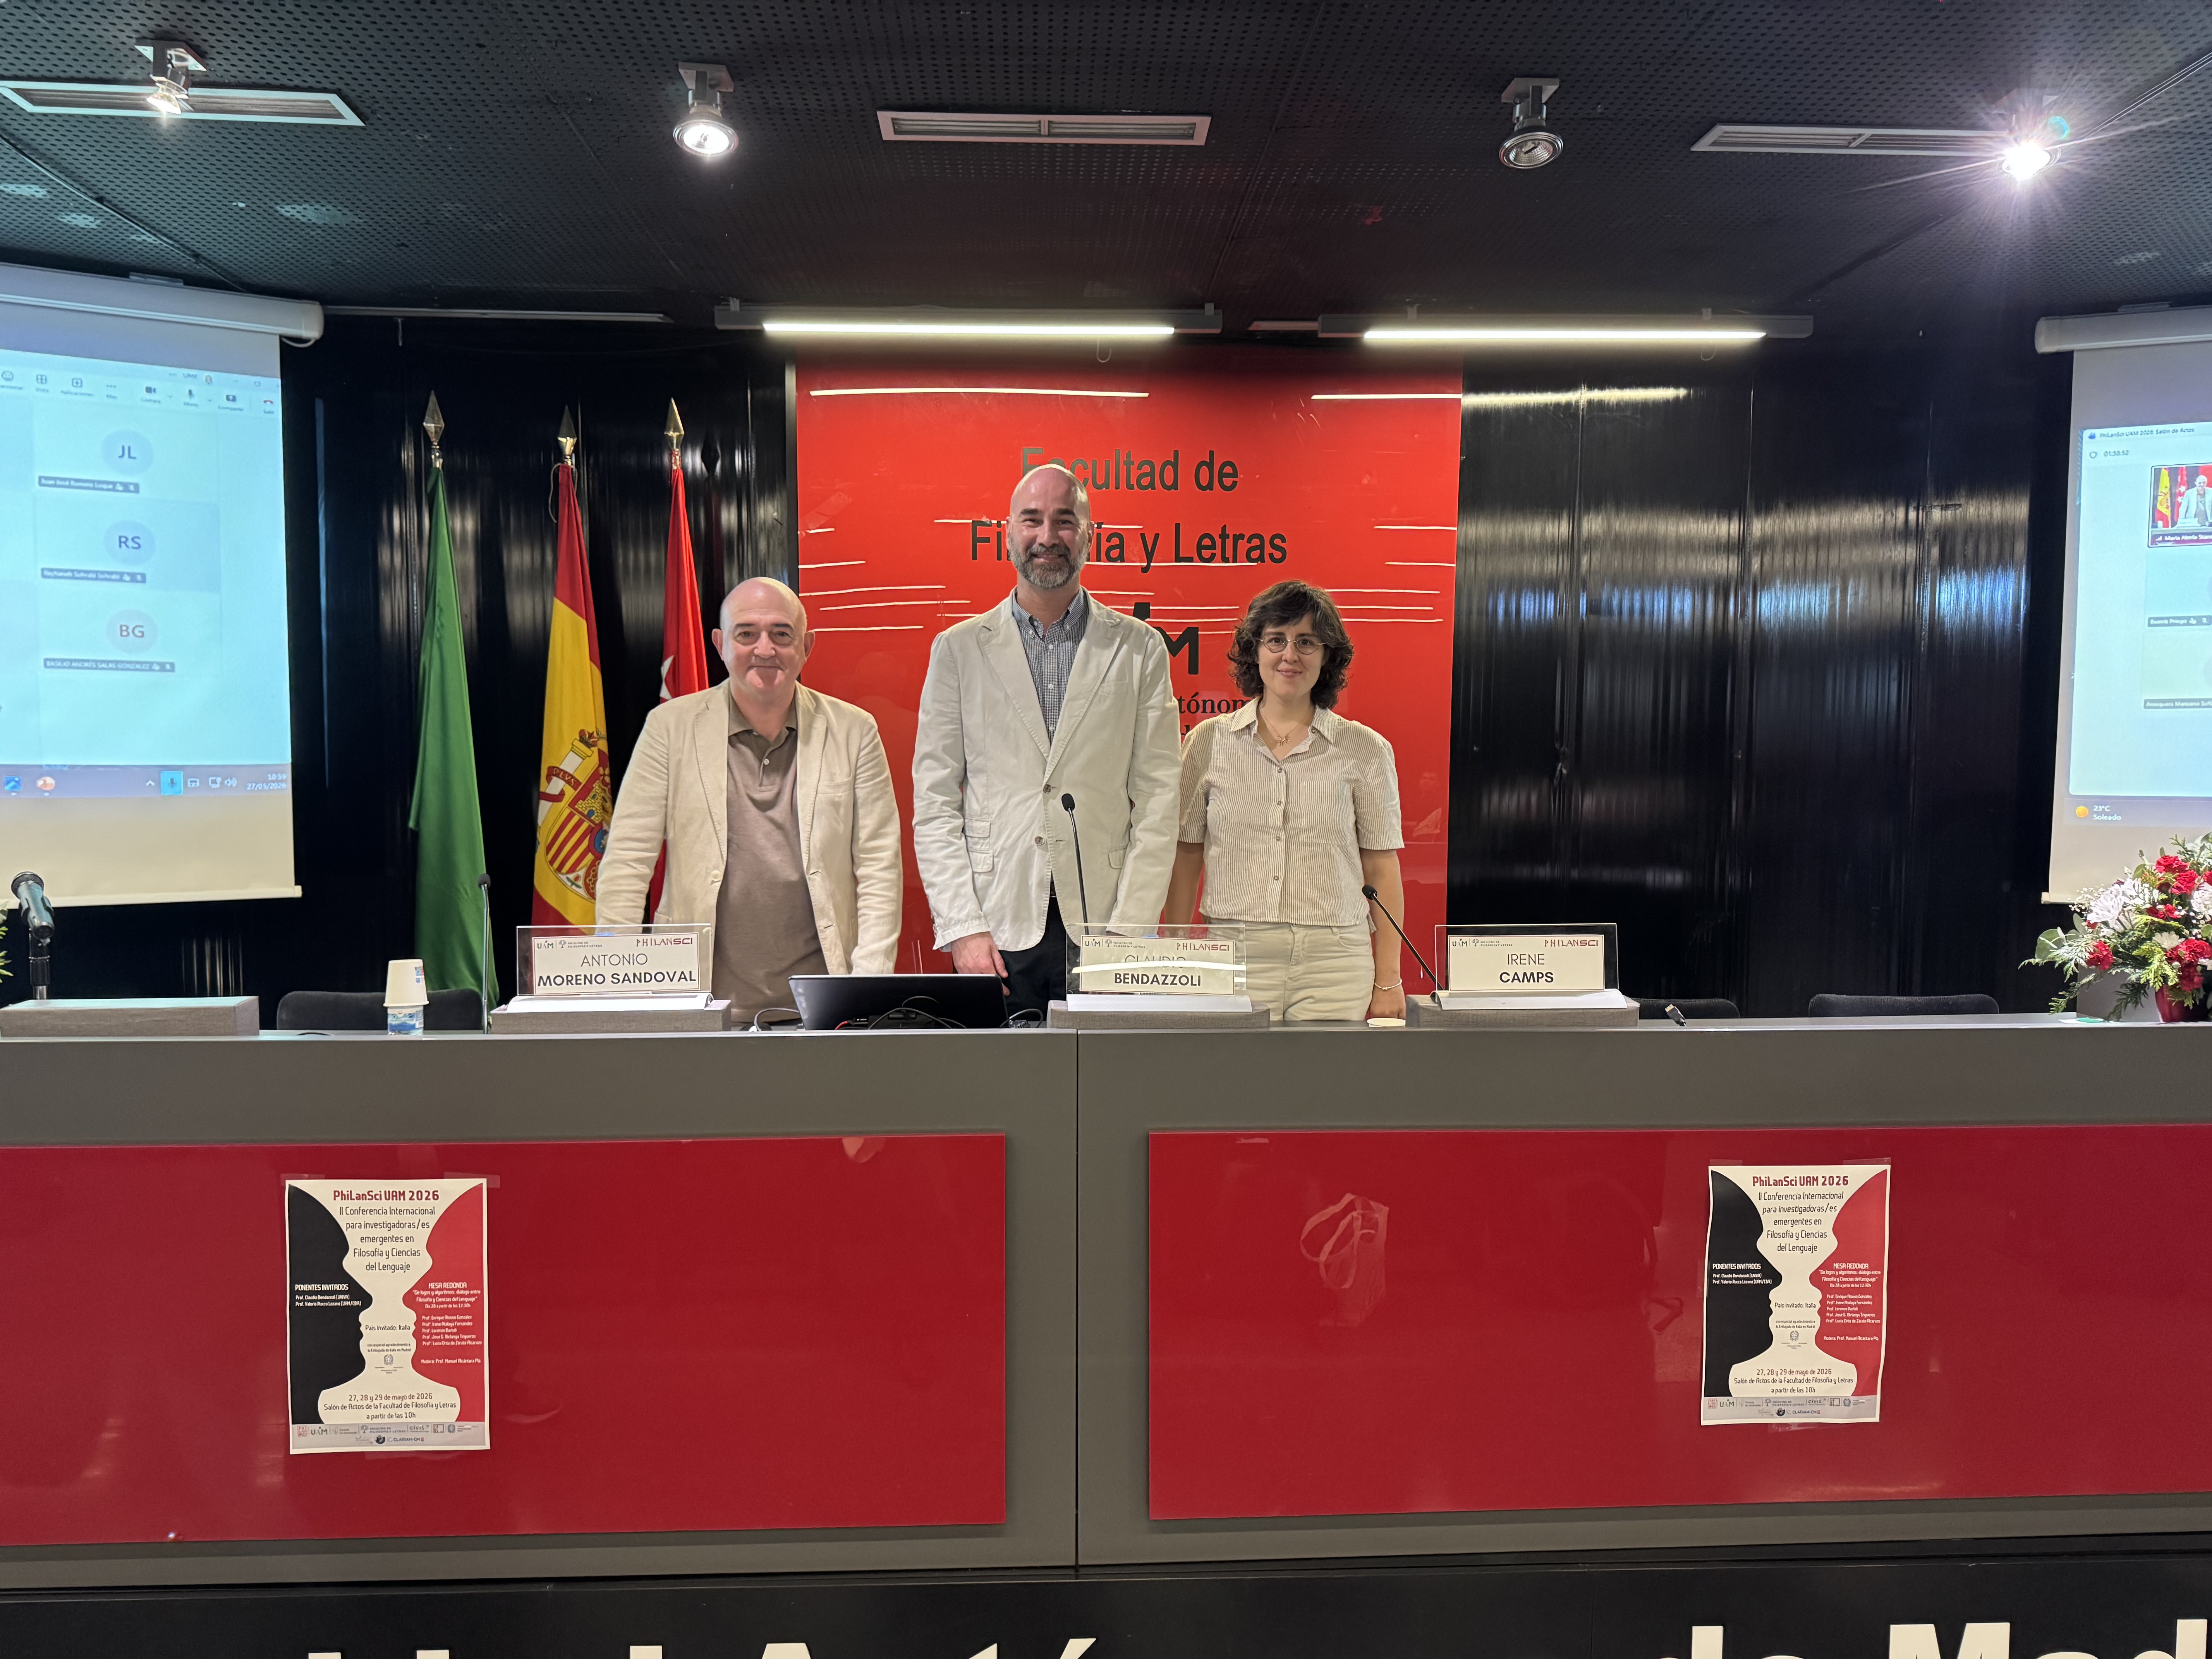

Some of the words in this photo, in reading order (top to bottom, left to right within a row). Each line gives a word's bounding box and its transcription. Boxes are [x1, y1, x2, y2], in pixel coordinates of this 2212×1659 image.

[118, 445, 136, 459] JL
[1022, 448, 1178, 491] Fcultad
[1195, 450, 1238, 491] de
[118, 536, 141, 550] RS
[1140, 533, 1160, 573] y
[1175, 523, 1287, 563] Letras
[120, 625, 144, 638] BG
[553, 767, 577, 786] PLVS
[581, 953, 647, 967] ANTONIO
[1508, 954, 1544, 965] IRENE
[538, 974, 605, 986] MORENO
[611, 971, 696, 984] SANDOVAL
[1115, 973, 1200, 986] BENDAZZOLI
[1500, 972, 1553, 982] CAMPS
[1753, 1176, 1797, 1186] PhiLanSci
[1800, 1176, 1818, 1186] UAM
[1822, 1176, 1848, 1186] 2026
[334, 1190, 382, 1200] PhiLanSci
[384, 1190, 405, 1200] UAM
[409, 1190, 439, 1200] 2026
[1803, 1191, 1843, 1199] Internacional
[340, 1207, 343, 1215] II
[345, 1207, 387, 1215] Conferencia
[390, 1206, 435, 1215] Internacional
[1779, 1203, 1837, 1214] investigadoras/es
[346, 1223, 362, 1231] para
[364, 1219, 429, 1231] investigadoras/es
[1774, 1218, 1812, 1227] emergentes
[361, 1235, 403, 1245] emergentes
[386, 1250, 389, 1259] y
[392, 1248, 420, 1256] Ciencias
[1789, 1243, 1817, 1254] Lenguaje
[366, 1262, 376, 1271] del
[378, 1262, 410, 1273] Lenguaje
